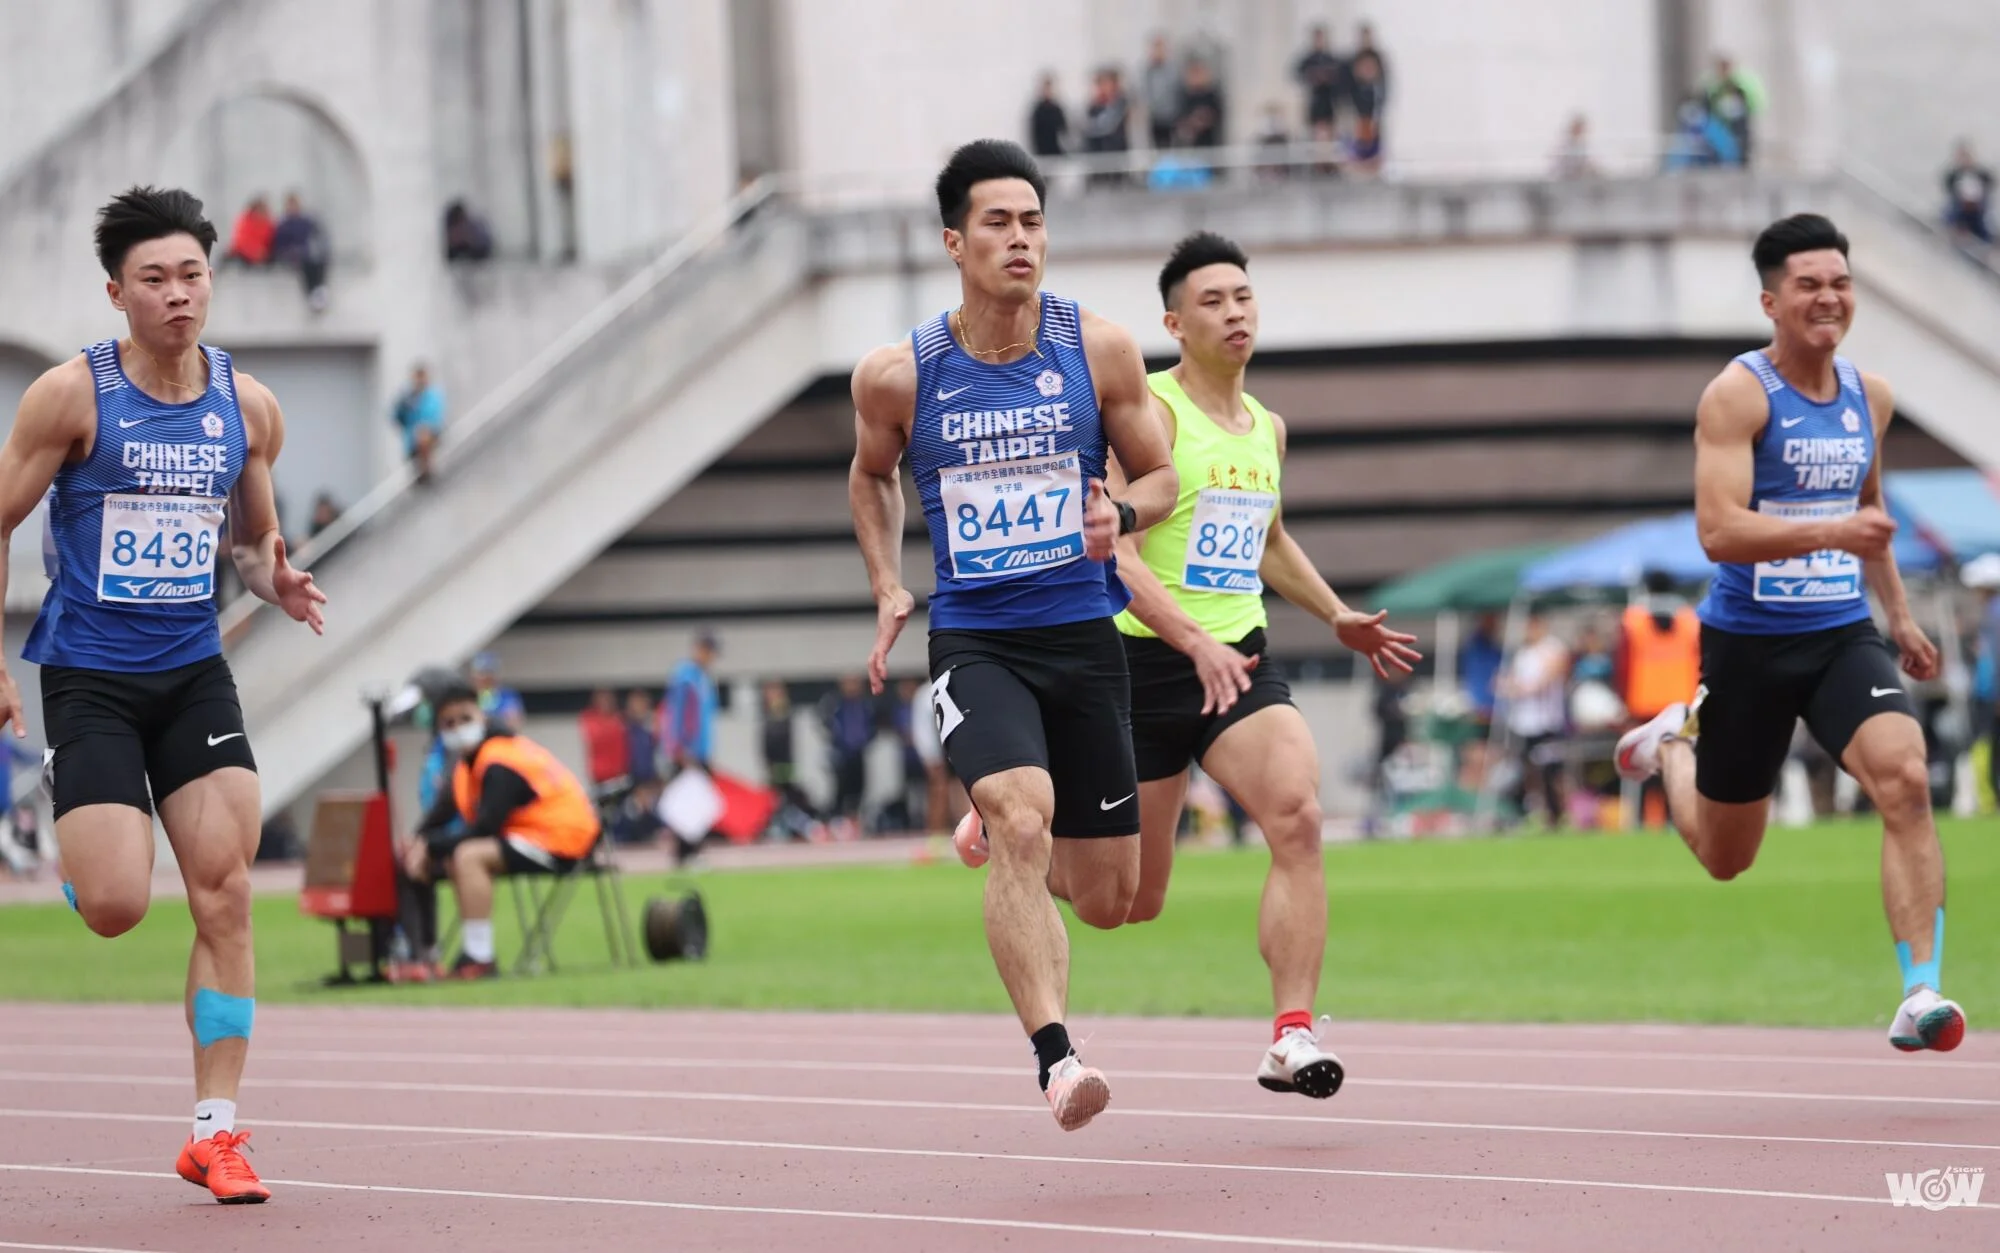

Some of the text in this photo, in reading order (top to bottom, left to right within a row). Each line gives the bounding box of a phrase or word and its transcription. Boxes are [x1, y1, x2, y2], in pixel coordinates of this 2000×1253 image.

[942, 403, 1074, 442] CHINESE
[122, 442, 228, 472] CHINESE
[958, 434, 1056, 465] TAIPEI
[1783, 437, 1867, 465] CHINESE
[135, 471, 215, 496] TAIPEI
[1795, 464, 1859, 490] TAIPEI
[957, 488, 1071, 542] 8447
[112, 529, 211, 569] 8436
